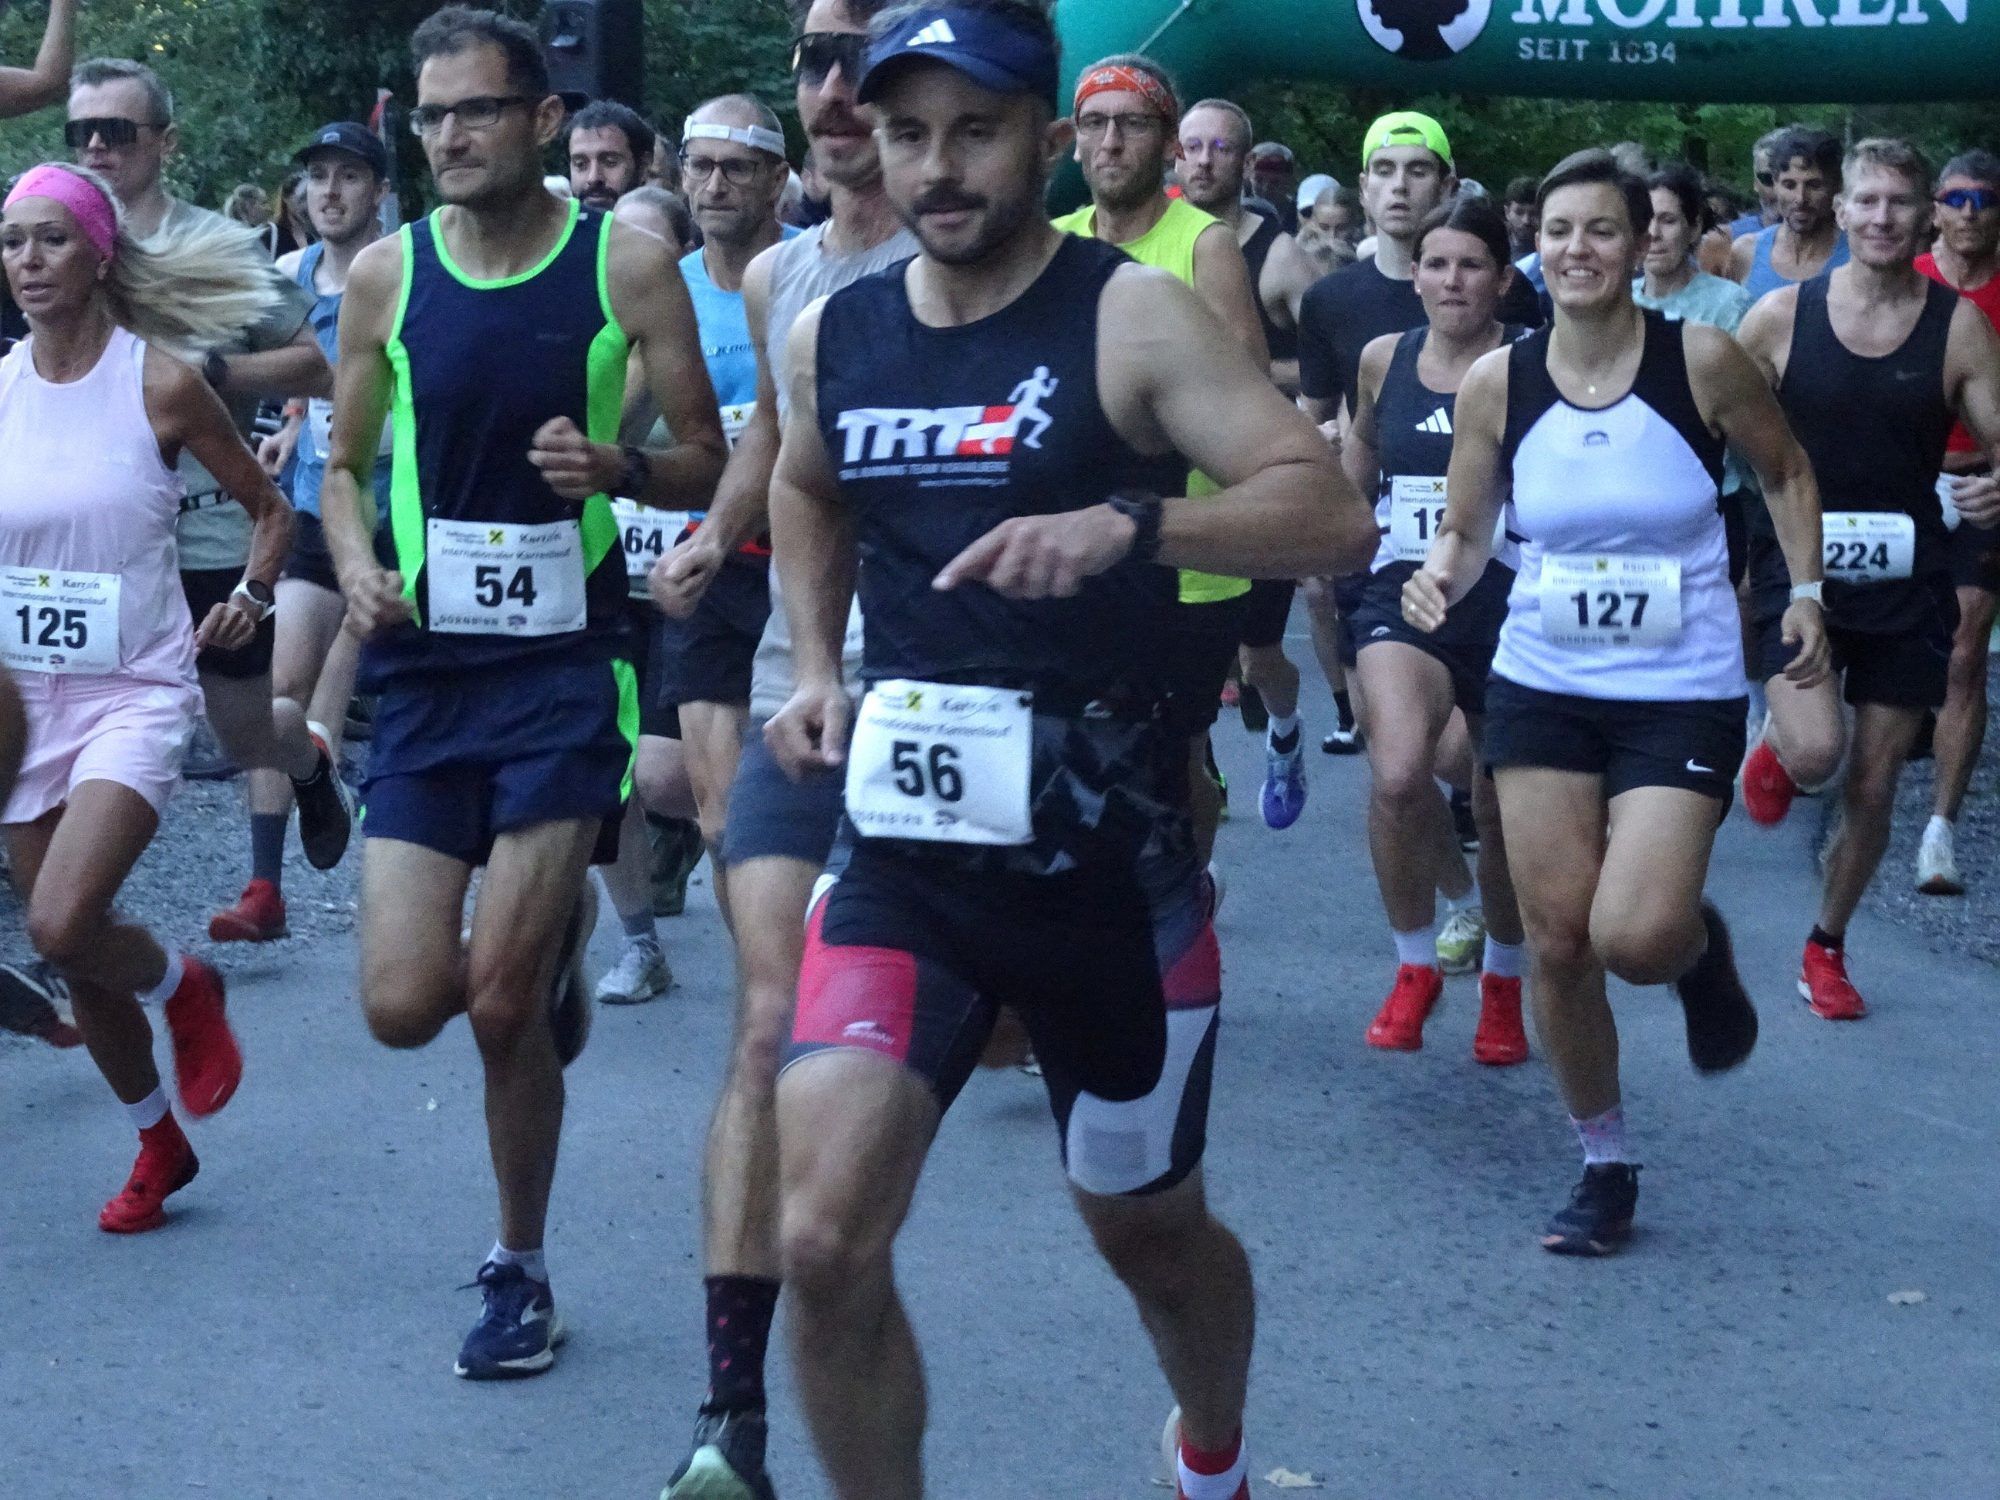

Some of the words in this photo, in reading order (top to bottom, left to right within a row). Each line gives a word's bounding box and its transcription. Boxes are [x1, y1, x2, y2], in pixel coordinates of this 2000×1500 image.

[1518, 37, 1590, 61] SEIT
[624, 526, 664, 556] 64
[1826, 541, 1890, 571] 224
[475, 565, 538, 608] 54
[16, 604, 88, 650] 125
[1570, 590, 1650, 629] 127
[892, 740, 964, 803] 56
